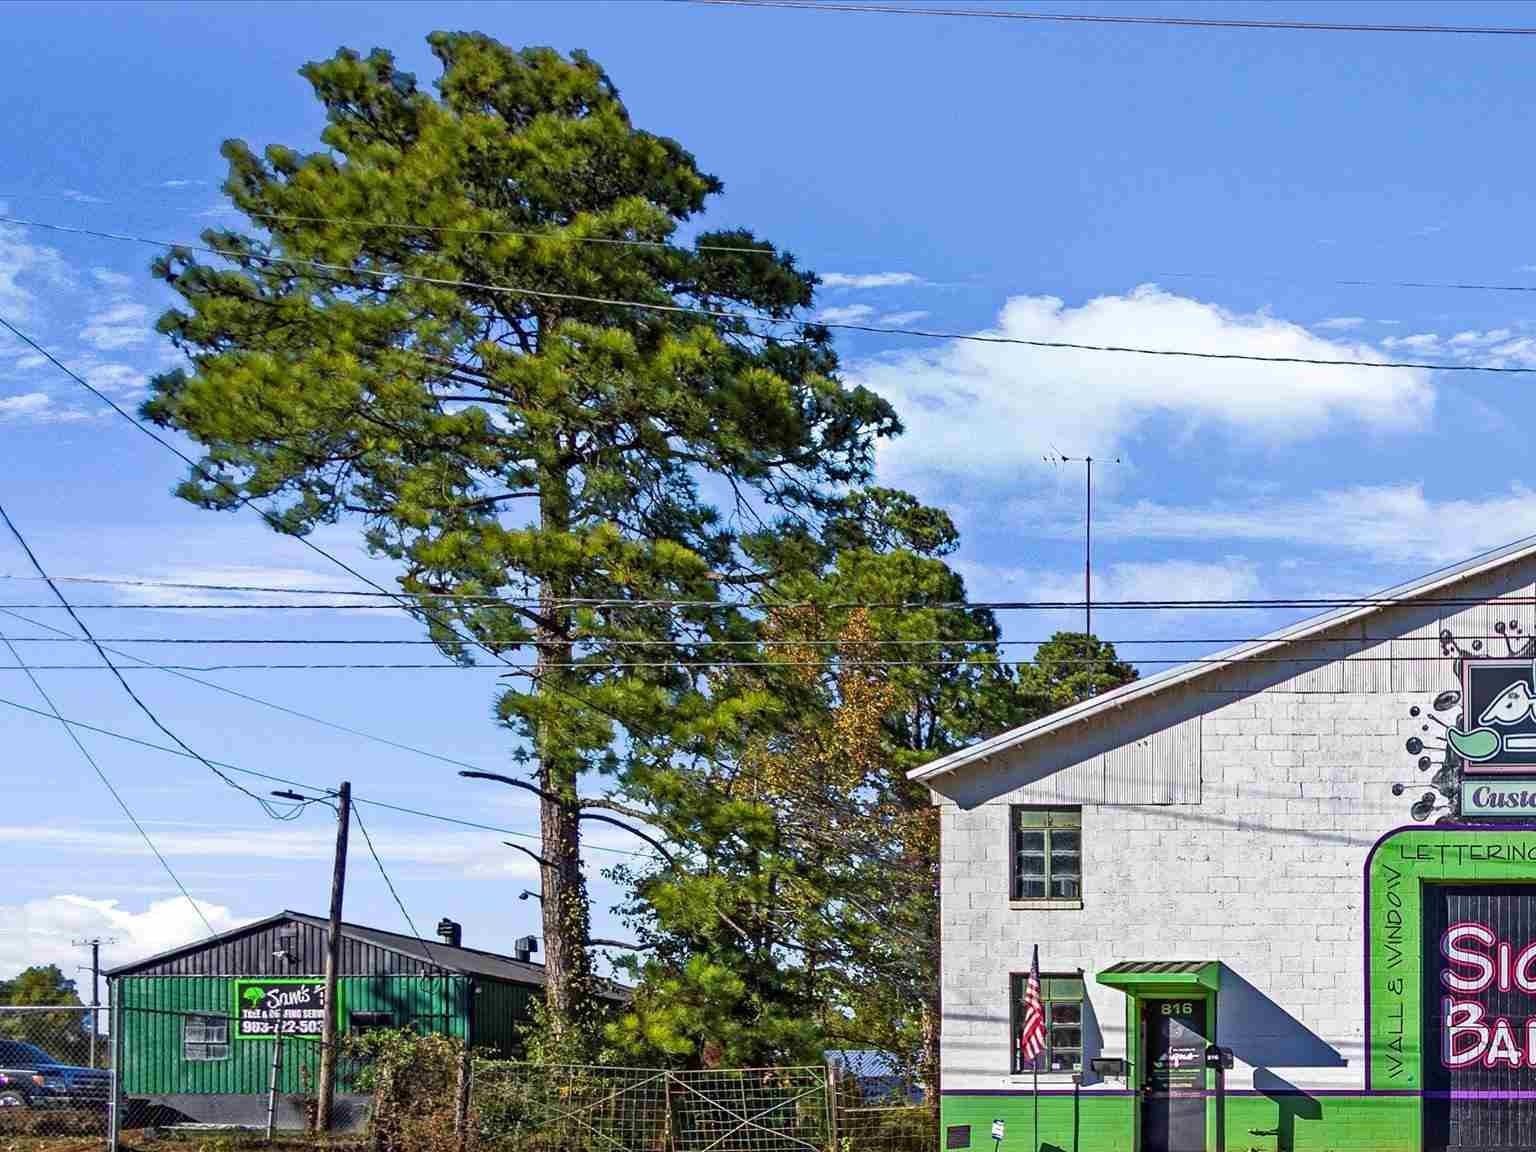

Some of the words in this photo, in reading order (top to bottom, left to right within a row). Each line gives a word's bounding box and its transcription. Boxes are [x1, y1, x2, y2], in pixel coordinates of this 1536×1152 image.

[1382, 863, 1403, 970] WINDOW
[266, 984, 311, 1009] Sam's
[1161, 1002, 1193, 1015] 816
[1385, 1002, 1404, 1079] WALL
